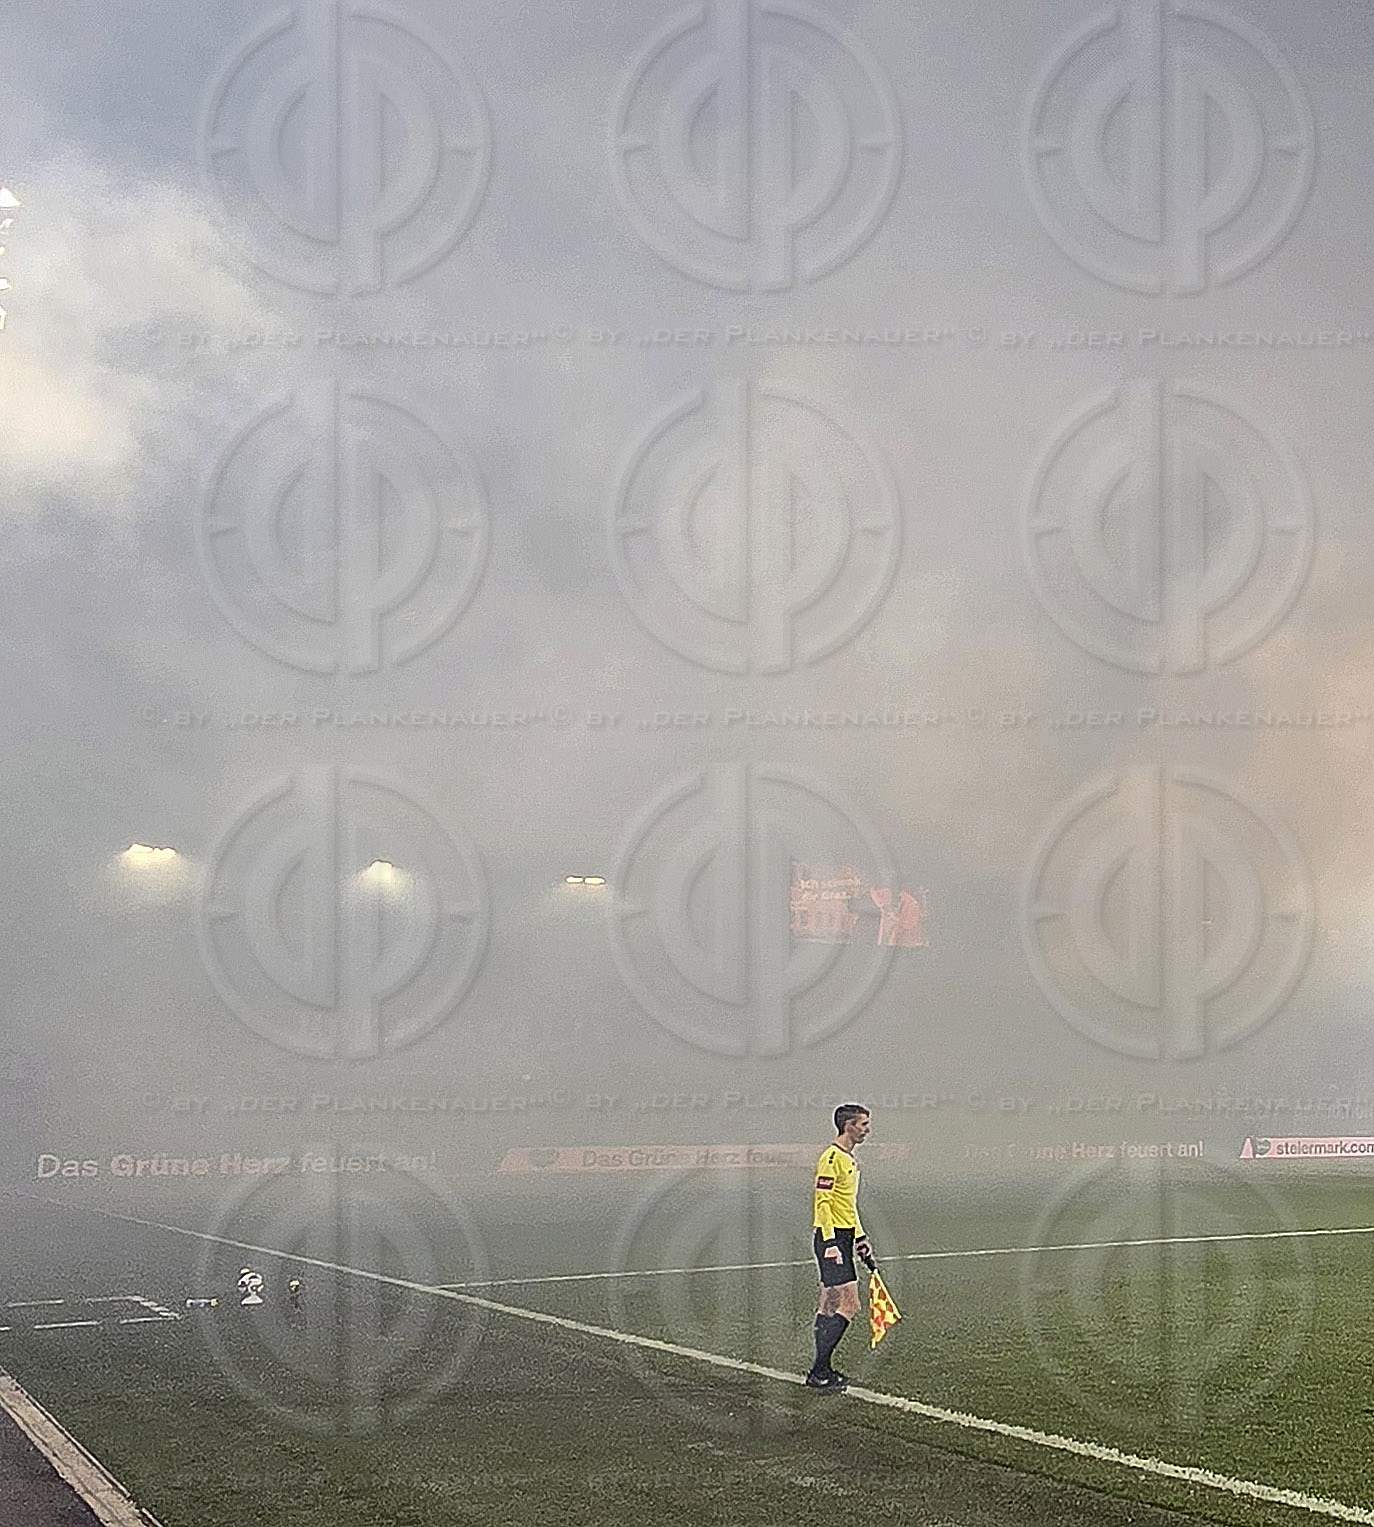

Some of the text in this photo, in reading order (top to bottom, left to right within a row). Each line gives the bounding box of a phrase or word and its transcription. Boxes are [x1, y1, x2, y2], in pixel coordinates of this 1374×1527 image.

[582, 1150, 622, 1168] Das
[1071, 1142, 1115, 1159] Herz
[1121, 1141, 1174, 1158] feuert
[1177, 1140, 1205, 1157] an!
[37, 1151, 438, 1178] Das Grüne Herz feuert an!
